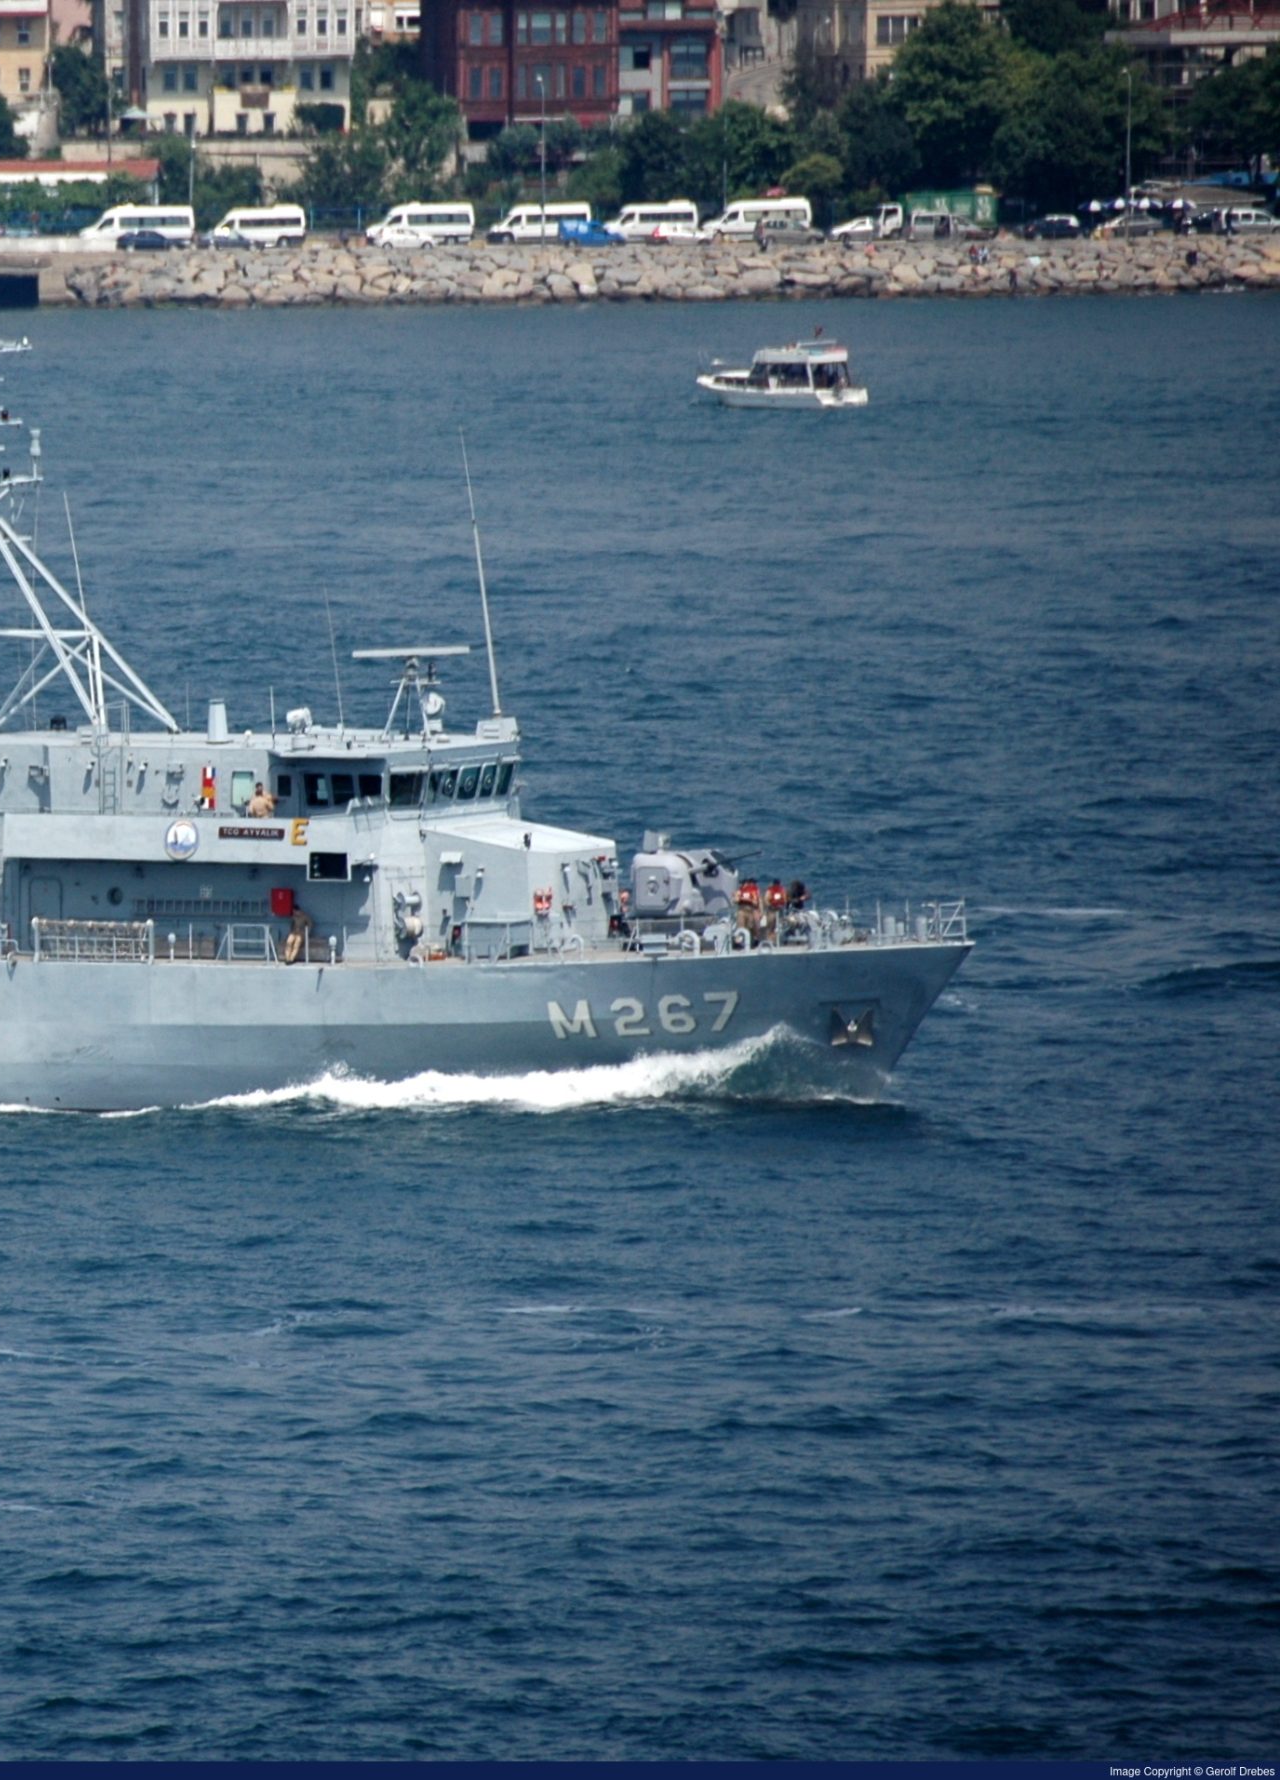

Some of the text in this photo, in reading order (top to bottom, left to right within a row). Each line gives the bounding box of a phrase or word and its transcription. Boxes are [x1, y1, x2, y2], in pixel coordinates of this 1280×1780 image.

[243, 829, 280, 837] AYVALIK
[291, 817, 309, 846] E
[547, 991, 738, 1039] M 267
